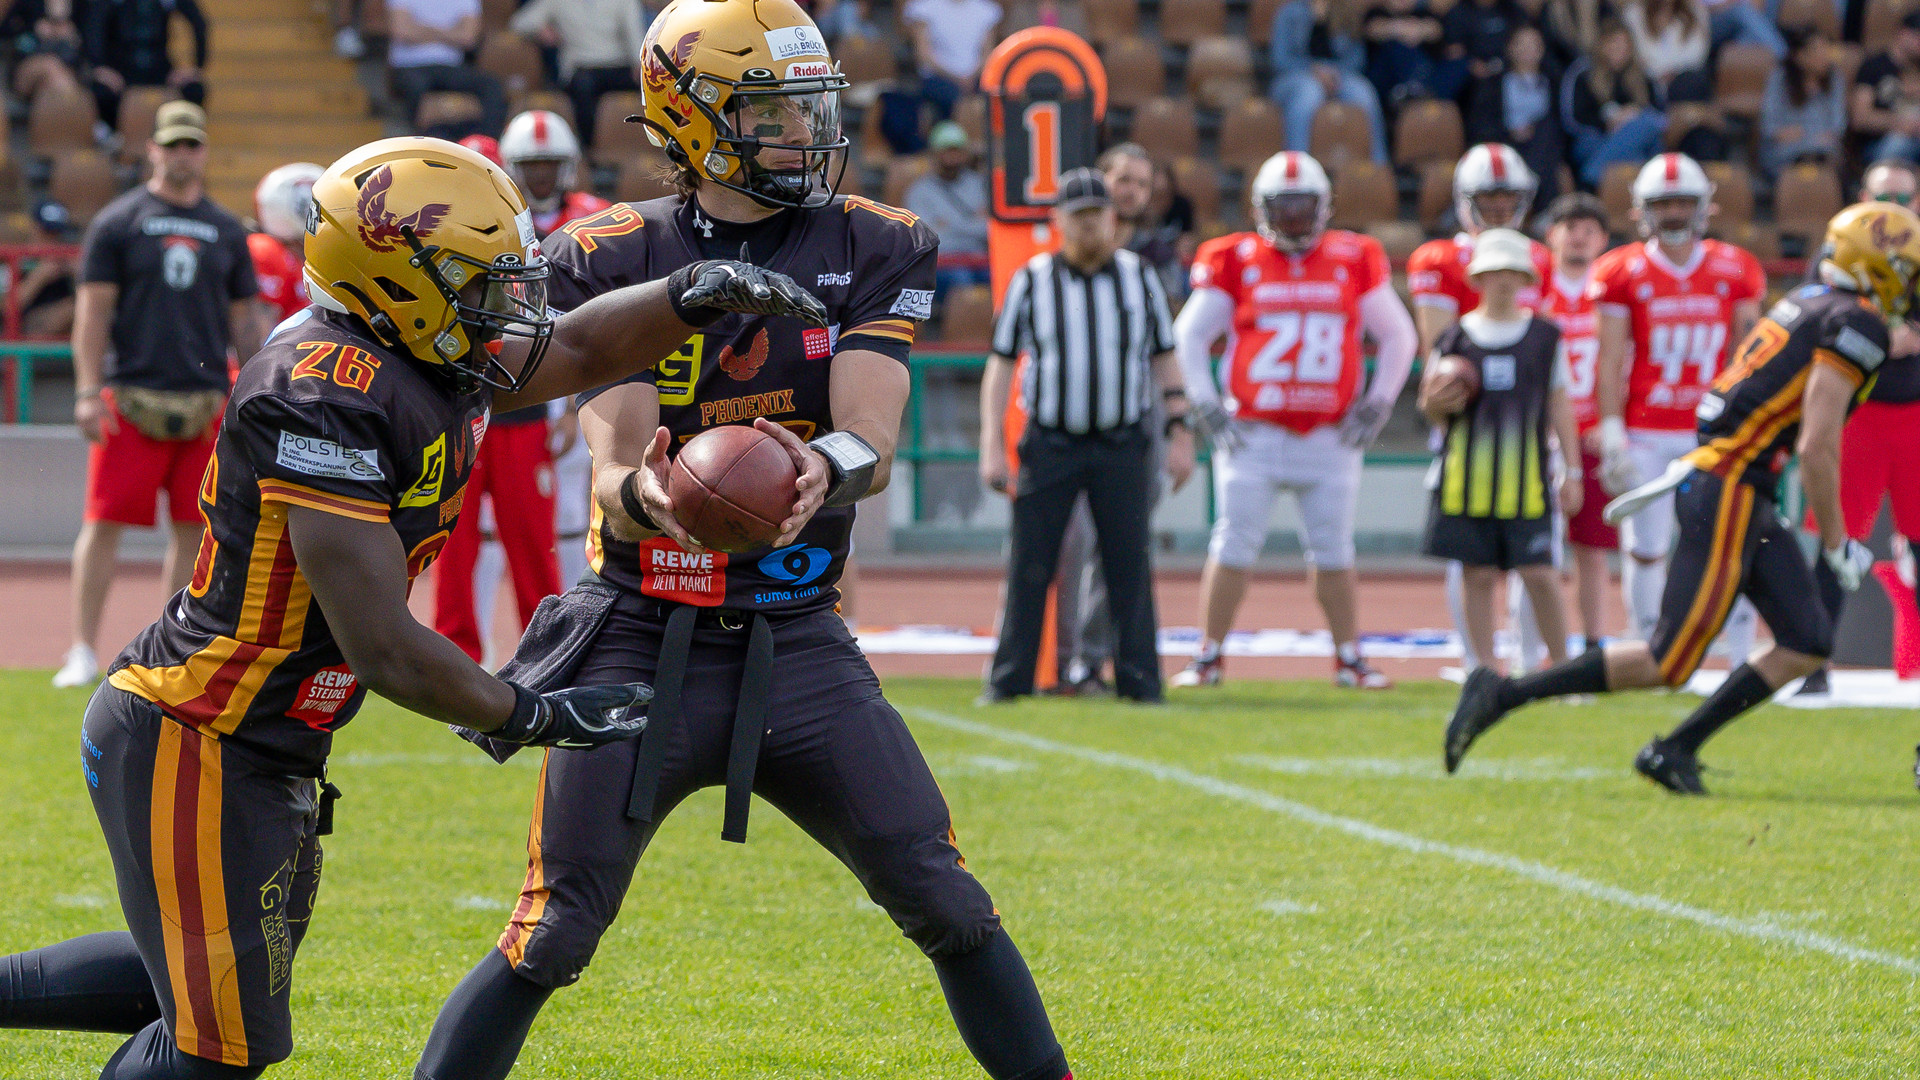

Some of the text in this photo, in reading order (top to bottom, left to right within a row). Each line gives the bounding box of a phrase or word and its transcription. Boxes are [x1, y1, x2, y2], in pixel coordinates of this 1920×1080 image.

[778, 43, 801, 54] LISA
[793, 64, 828, 77] Riddell
[1024, 103, 1060, 203] 1
[562, 202, 645, 254] 12
[900, 290, 936, 306] POLS
[804, 332, 828, 341] effect
[1249, 310, 1349, 383] 28
[1650, 323, 1728, 386] 44
[291, 341, 382, 394] 26
[700, 388, 796, 426] PHOENIX
[282, 432, 364, 461] POLSTER
[280, 458, 297, 470] BORN
[297, 463, 307, 472] TO
[281, 451, 347, 471] TRAGWERKSPLANUNG
[652, 548, 714, 569] REWE
[652, 574, 713, 593] DEIN MARKT
[755, 590, 792, 604] suma
[313, 670, 355, 688] REWE
[308, 685, 347, 700] STEIDEL
